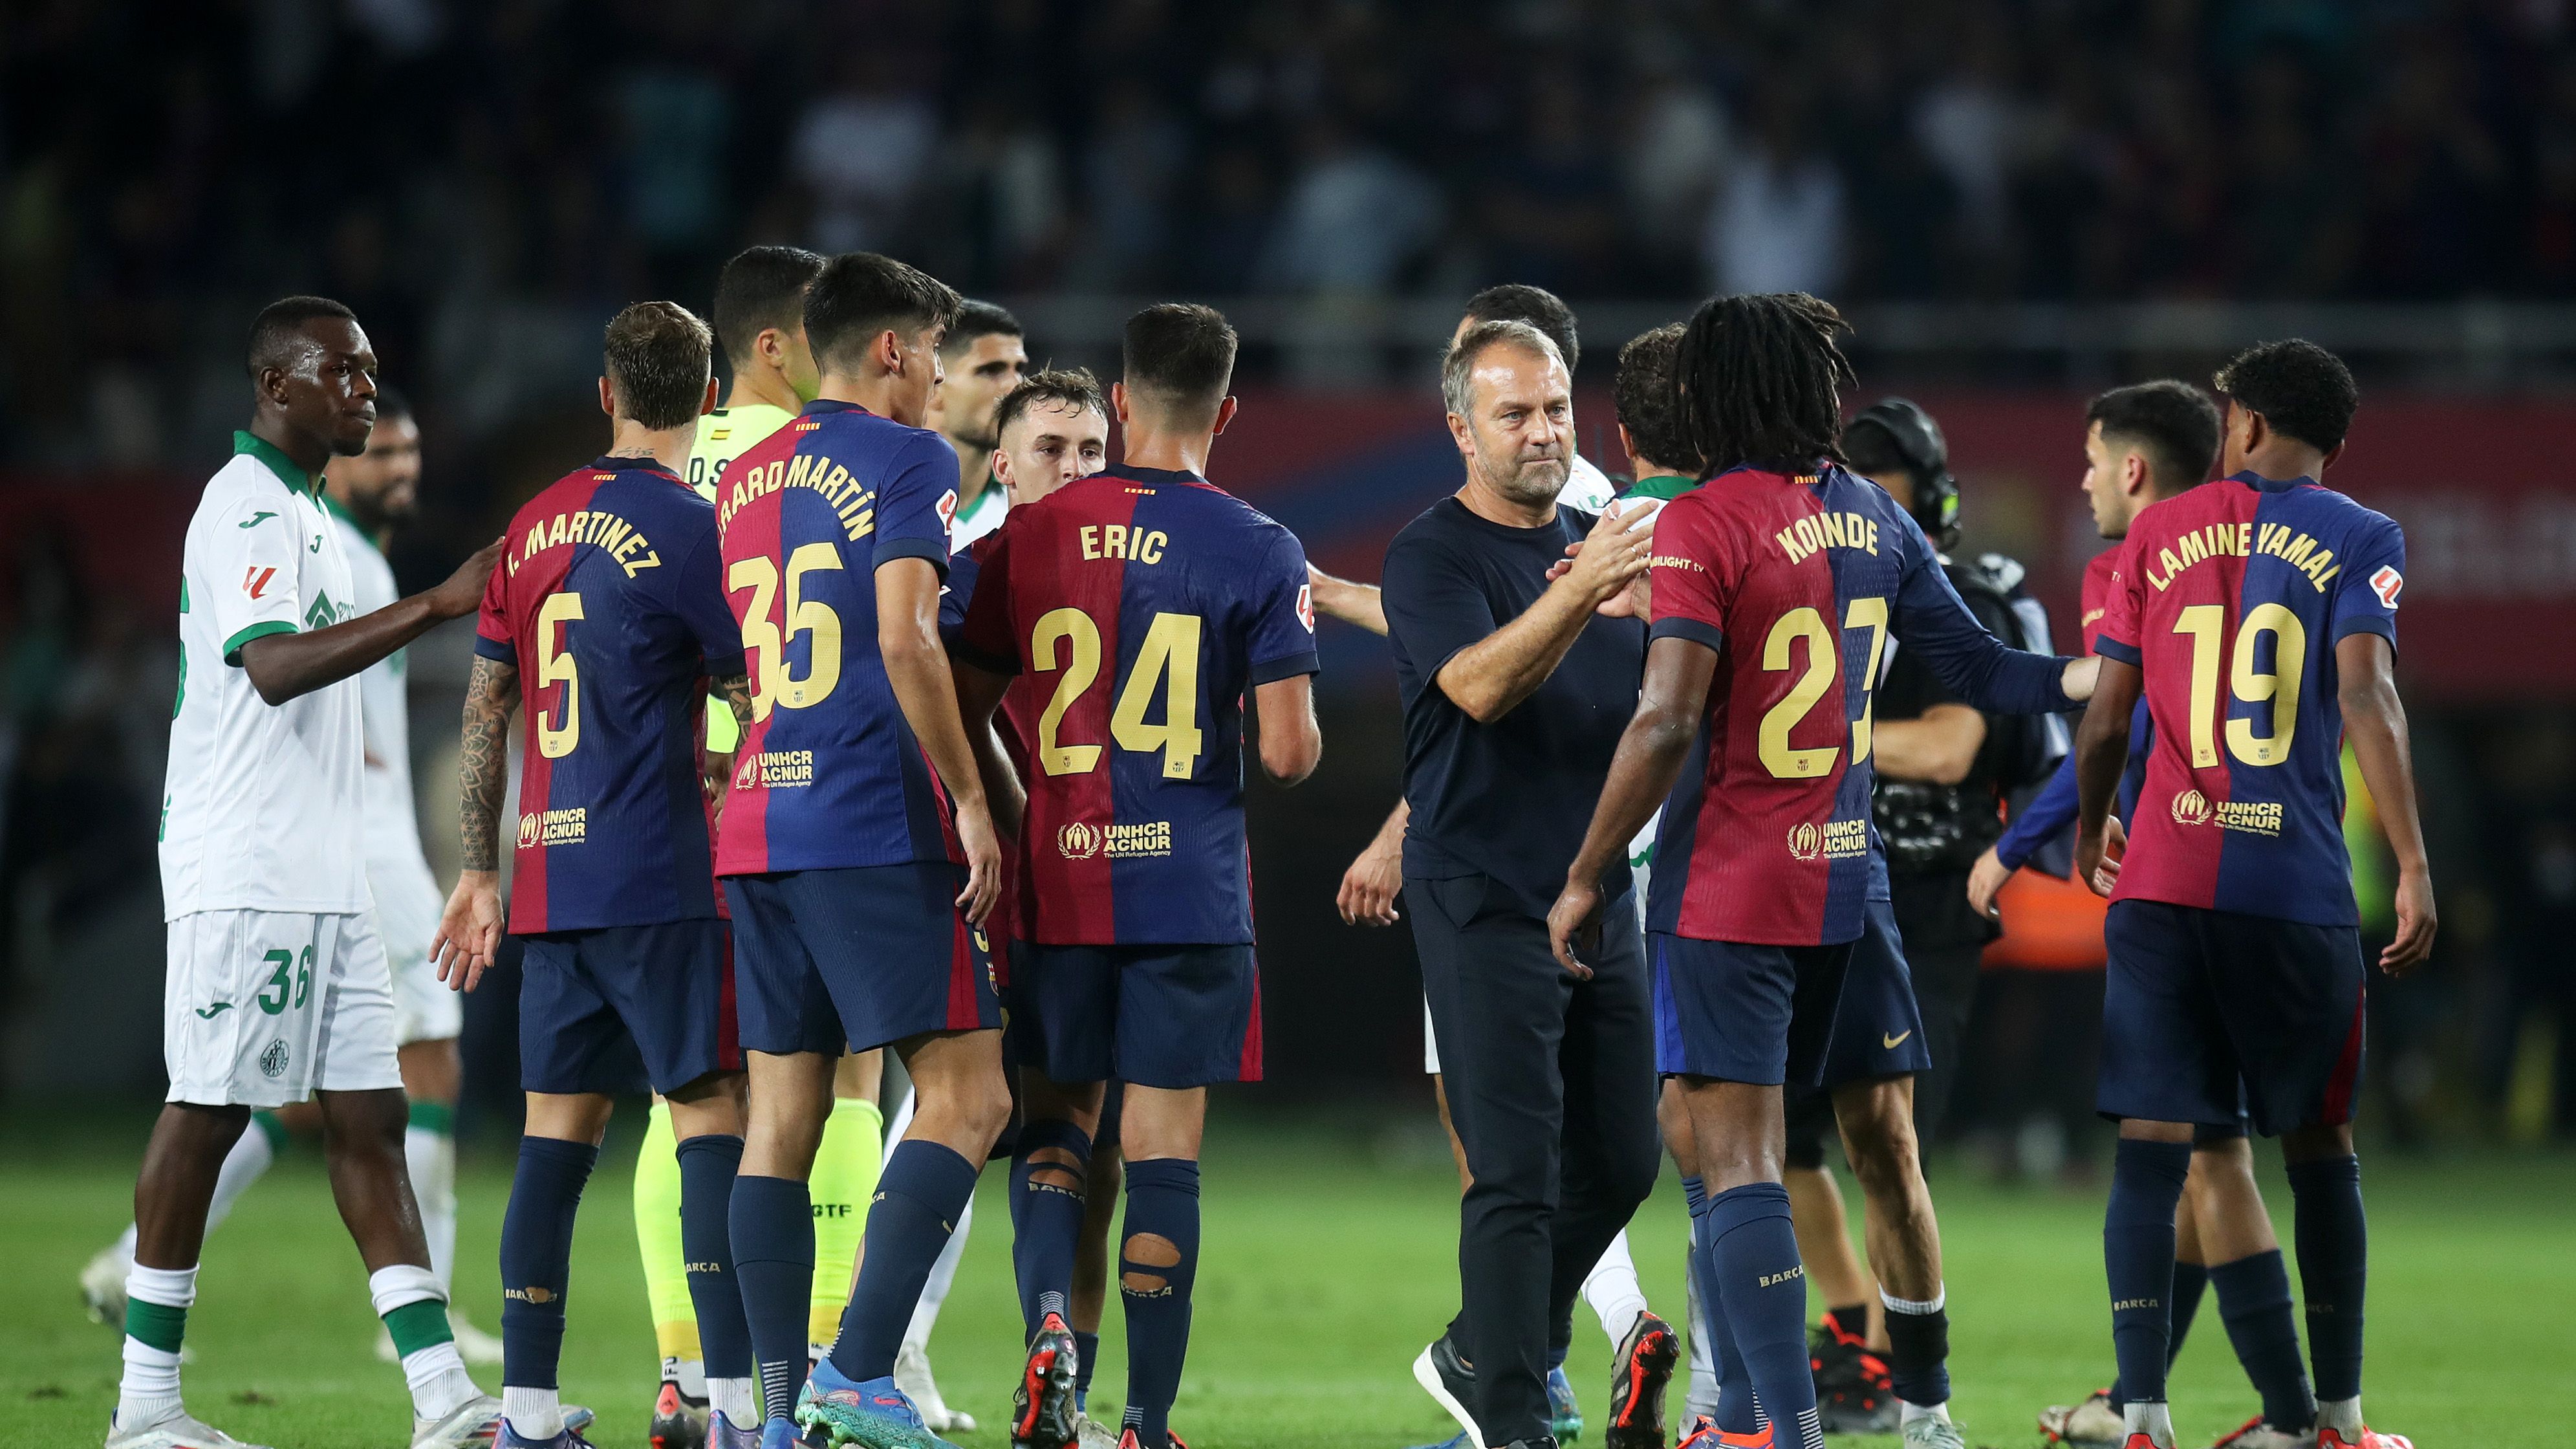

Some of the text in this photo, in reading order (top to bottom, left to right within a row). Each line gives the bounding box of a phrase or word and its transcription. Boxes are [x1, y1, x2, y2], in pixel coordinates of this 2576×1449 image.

[719, 461, 785, 550] RARD
[524, 511, 662, 580] MARTINEZ
[1079, 524, 1167, 565] ERIC
[2146, 522, 2252, 593] LAMINE
[2257, 522, 2342, 594] YAMAL
[729, 541, 844, 724] 35
[537, 592, 585, 759] 5
[1032, 607, 1202, 780] 24
[2171, 602, 2306, 770] 19
[758, 750, 813, 767] UNHCR
[761, 765, 812, 782] ACNUR
[543, 807, 586, 825] UNHCR
[2216, 801, 2283, 817] UNHCR
[541, 822, 585, 840] ACNUR
[1104, 821, 1171, 839] UNHCR
[1823, 819, 1865, 838] UNHCR
[2214, 813, 2281, 831] ACNUR
[1103, 835, 1171, 852] ACNUR
[1823, 834, 1867, 853] ACNUR
[259, 944, 312, 1015] 36
[811, 1204, 852, 1217] GTF
